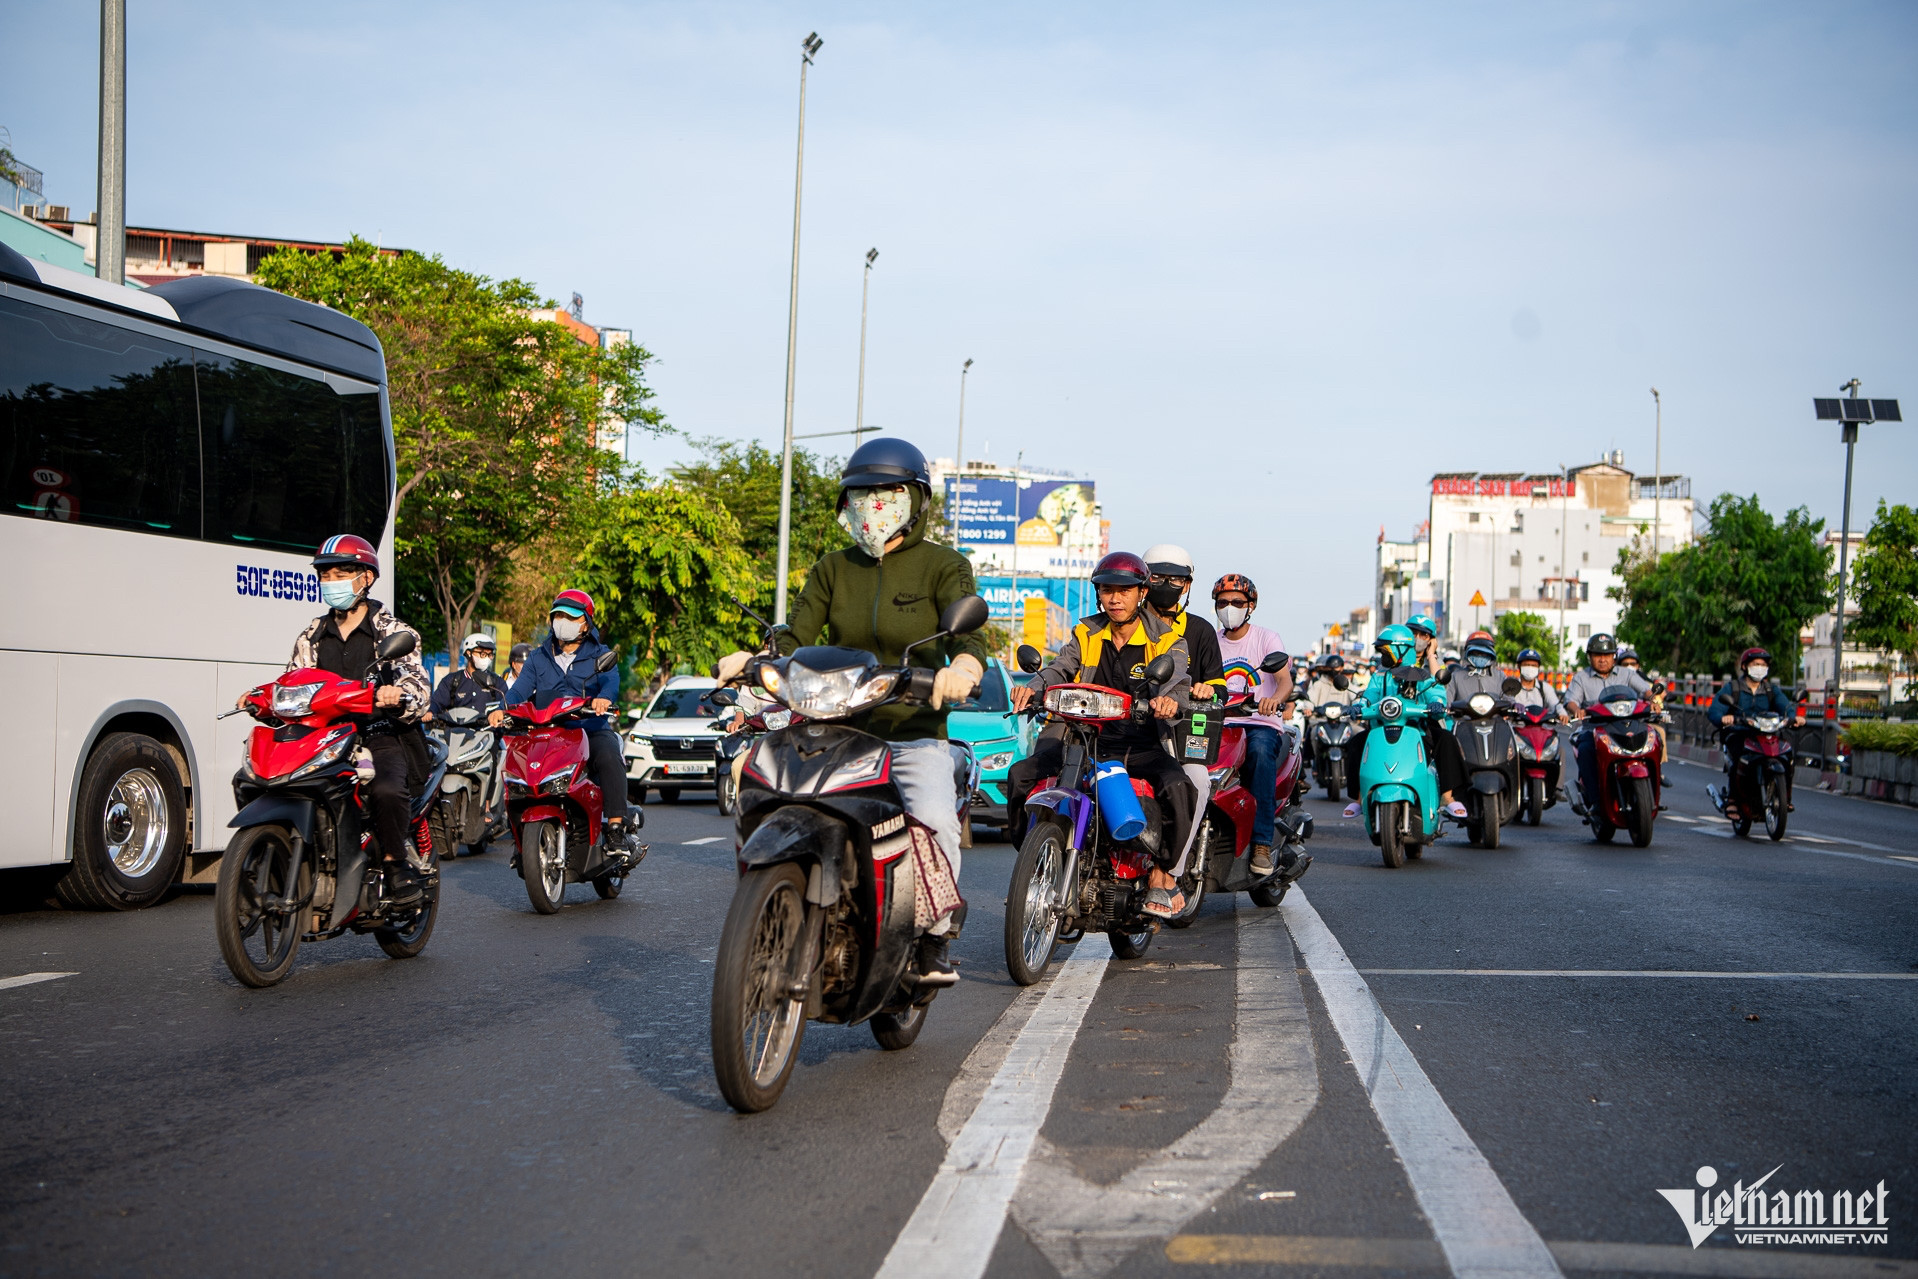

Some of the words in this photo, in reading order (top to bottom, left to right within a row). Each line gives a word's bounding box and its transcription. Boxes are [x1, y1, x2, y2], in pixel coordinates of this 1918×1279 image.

[959, 529, 982, 539] 1800
[983, 529, 1007, 540] 1299
[898, 592, 920, 600] NIKE
[871, 813, 905, 840] YAMAHA
